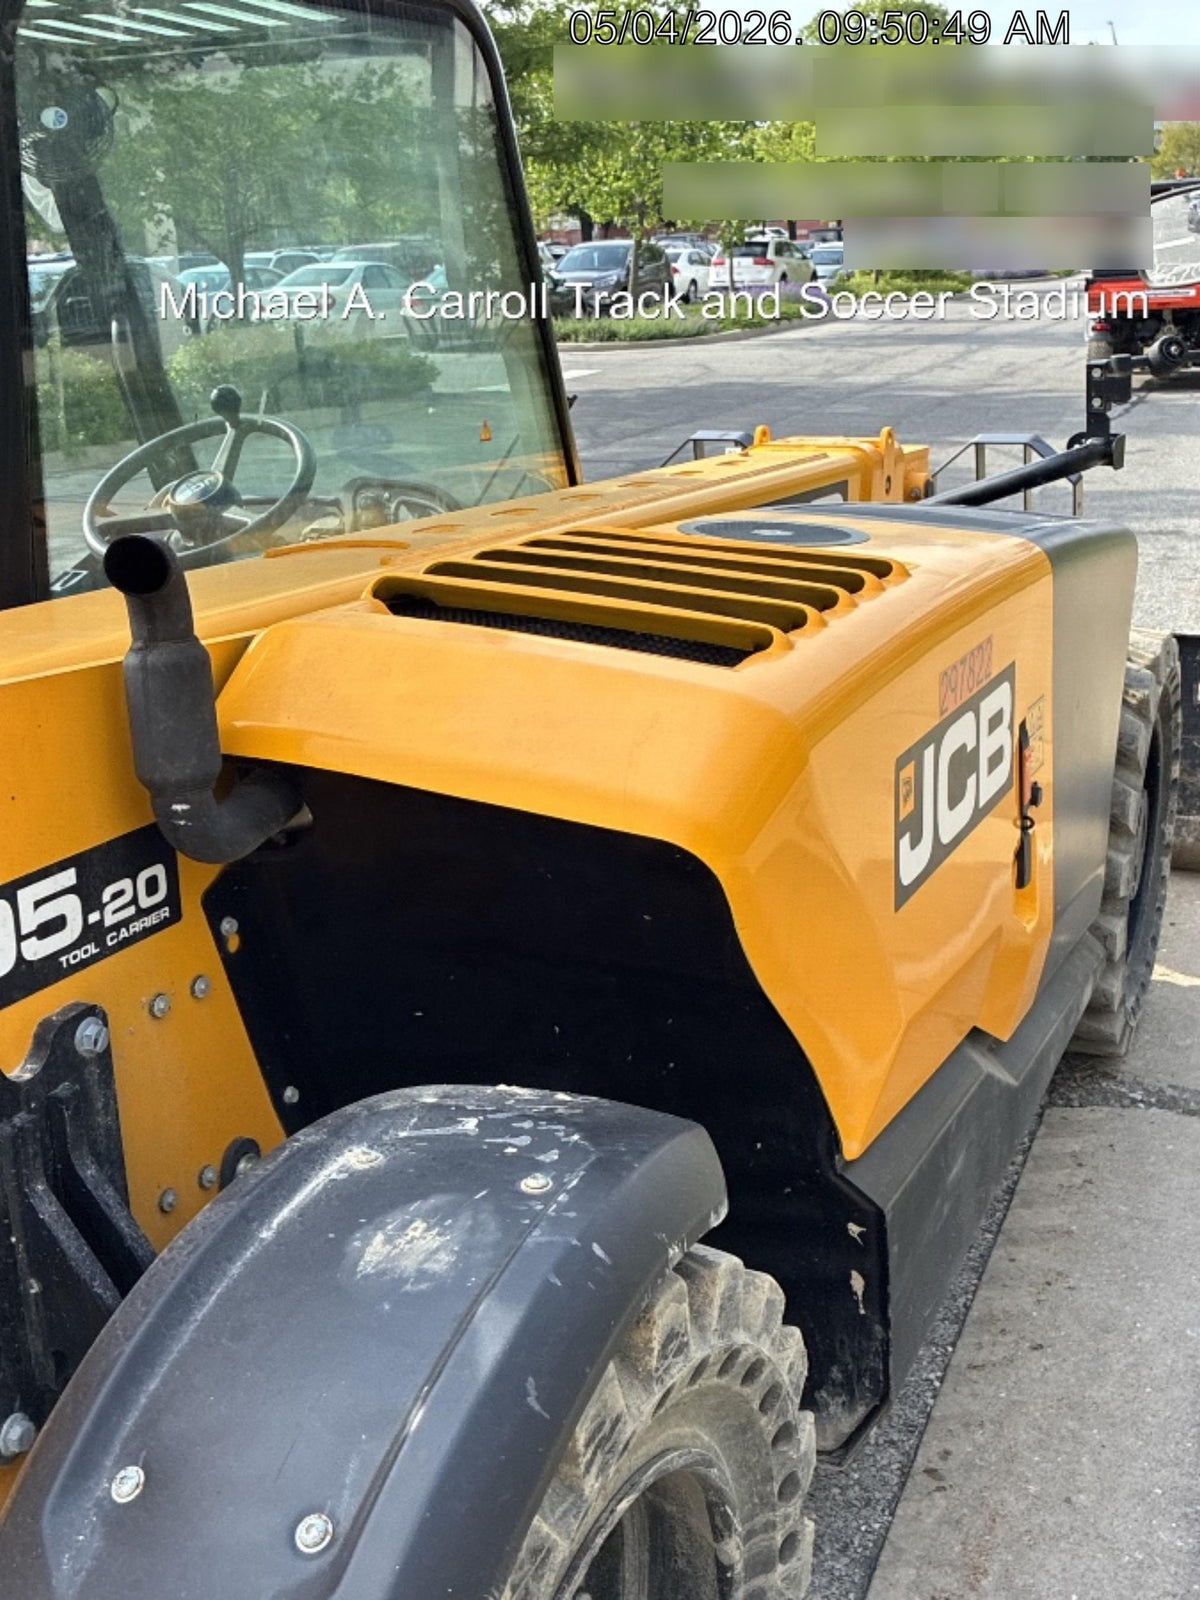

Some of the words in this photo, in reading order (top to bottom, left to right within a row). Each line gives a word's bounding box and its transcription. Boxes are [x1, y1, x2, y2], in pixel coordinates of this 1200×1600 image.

[899, 681, 1013, 887] JCB
[0, 863, 168, 978] 5-20
[59, 942, 100, 968] TOOL
[106, 906, 170, 947] CARRIER
